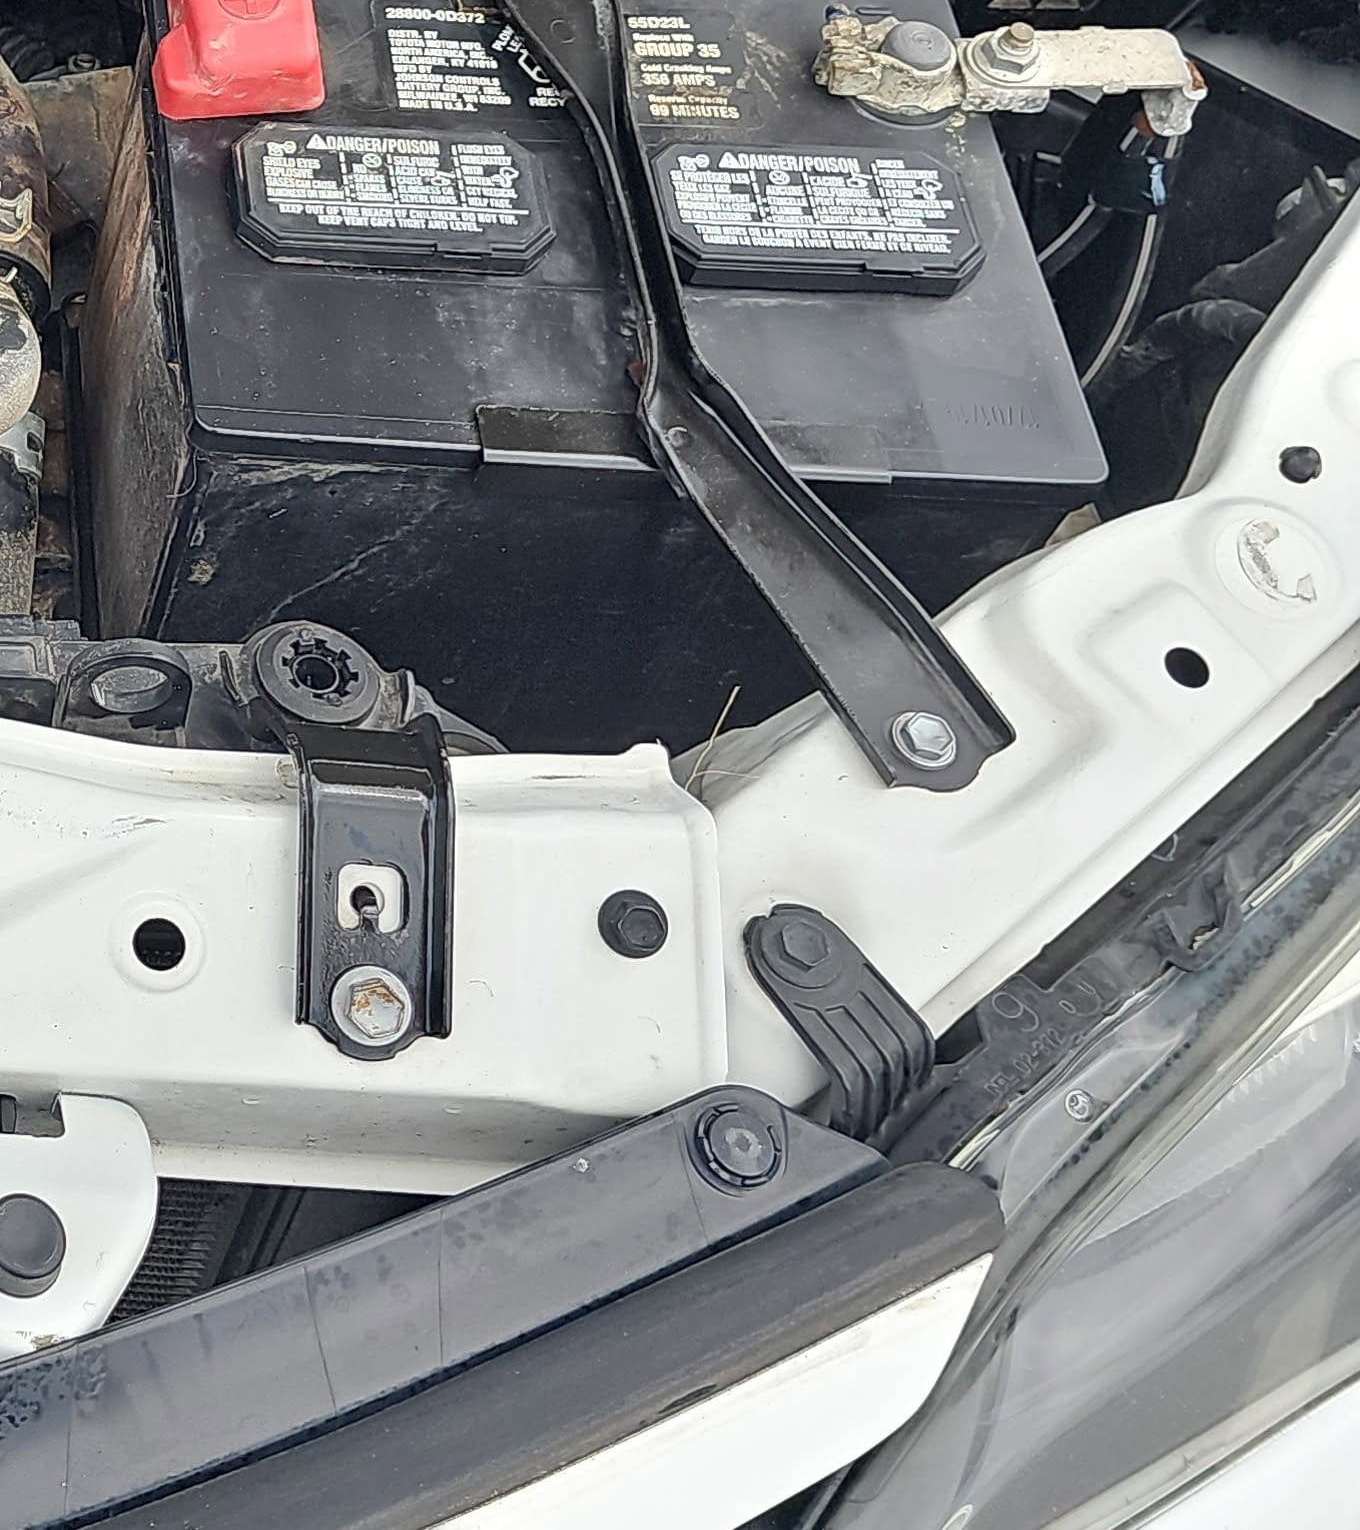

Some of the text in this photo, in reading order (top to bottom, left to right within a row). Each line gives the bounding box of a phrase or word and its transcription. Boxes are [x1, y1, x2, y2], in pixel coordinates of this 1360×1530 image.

[385, 7, 485, 24] 28800-0D372
[389, 38, 425, 47] TOYOTA
[633, 42, 721, 58] GROUP 35
[673, 74, 716, 87] AMPS
[672, 104, 740, 119] MINUTES
[326, 136, 440, 155] DANGER/POISON
[738, 153, 860, 173] DANGER/POISON
